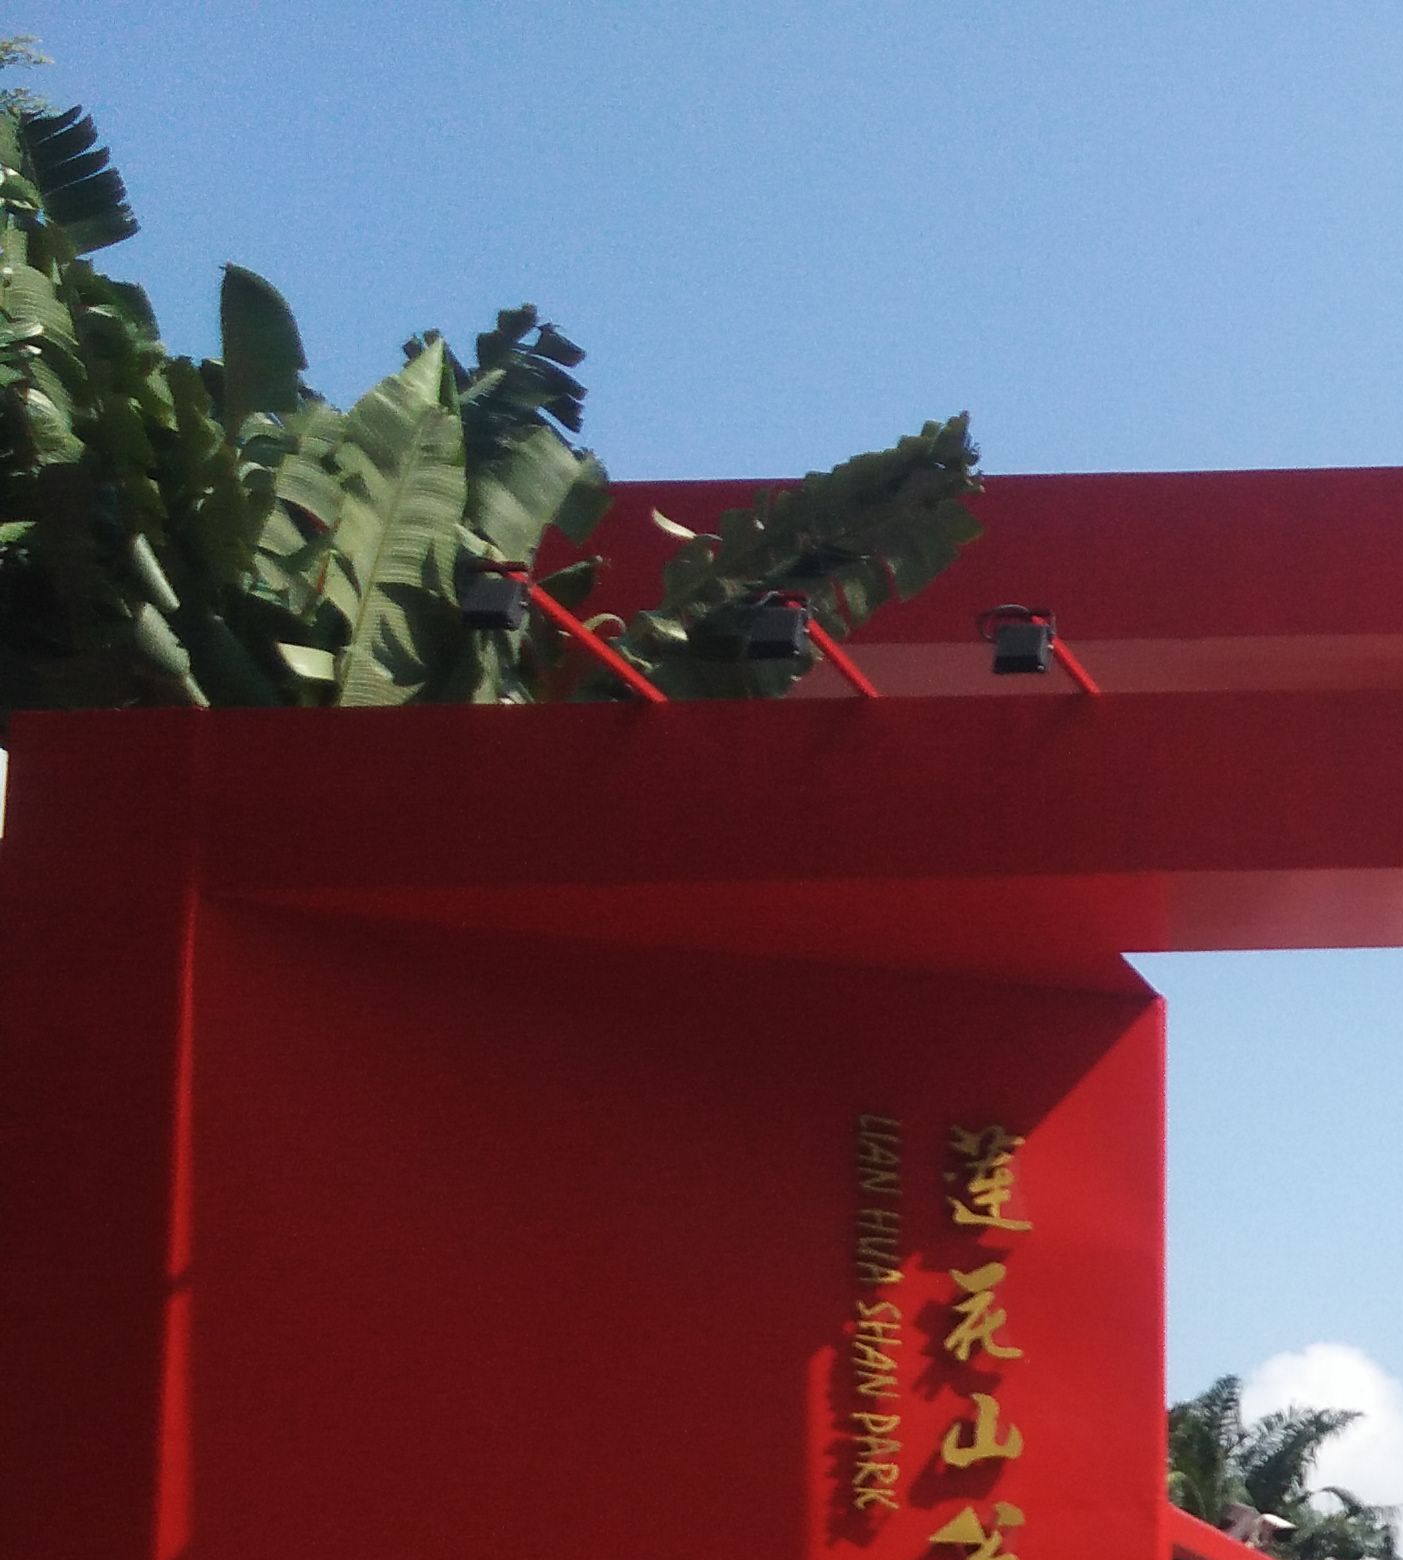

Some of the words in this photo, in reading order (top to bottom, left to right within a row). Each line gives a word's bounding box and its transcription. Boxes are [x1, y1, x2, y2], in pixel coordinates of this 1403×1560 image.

[858, 1113, 902, 1195] LIAN
[857, 1208, 904, 1283] HUA
[853, 1301, 902, 1398] SHAN
[852, 1413, 903, 1509] PARK
